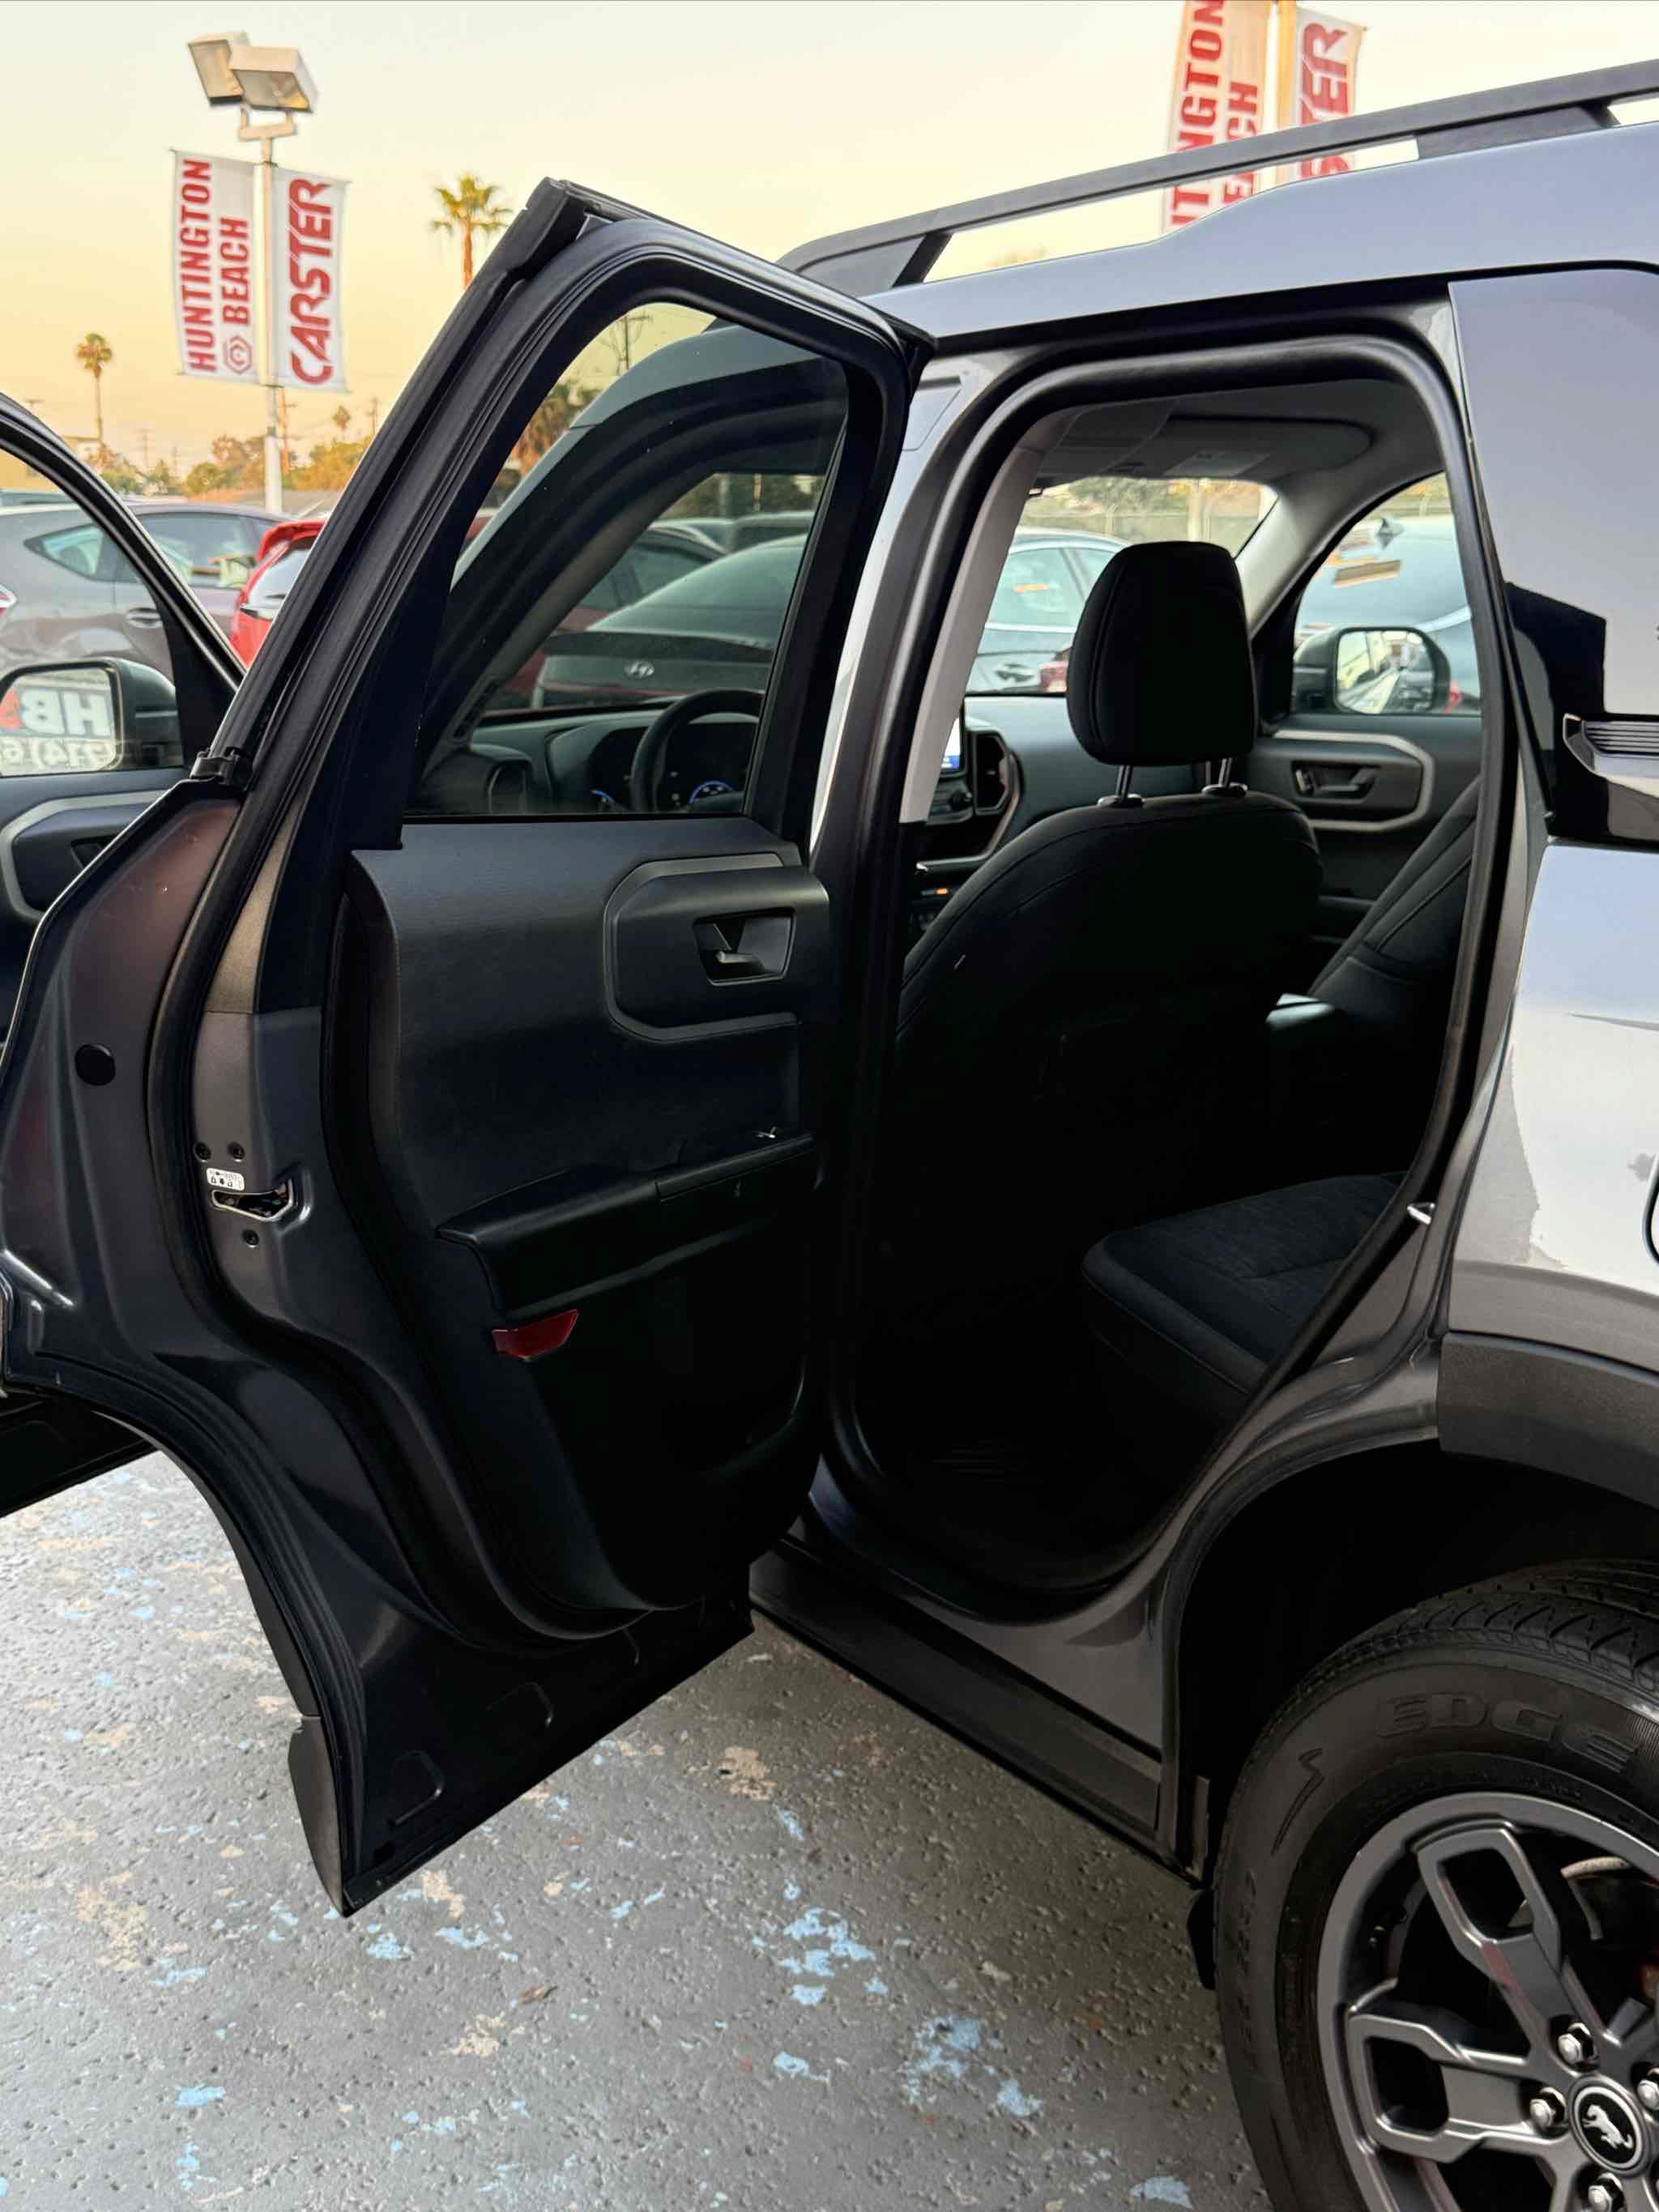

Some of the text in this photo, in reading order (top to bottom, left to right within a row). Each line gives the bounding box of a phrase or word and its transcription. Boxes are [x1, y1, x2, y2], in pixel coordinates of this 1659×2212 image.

[180, 158, 217, 373] HUNTINGTON
[219, 216, 251, 327] BEACH
[288, 177, 335, 386] CARSTER
[1376, 1690, 1638, 1774] EDGE
